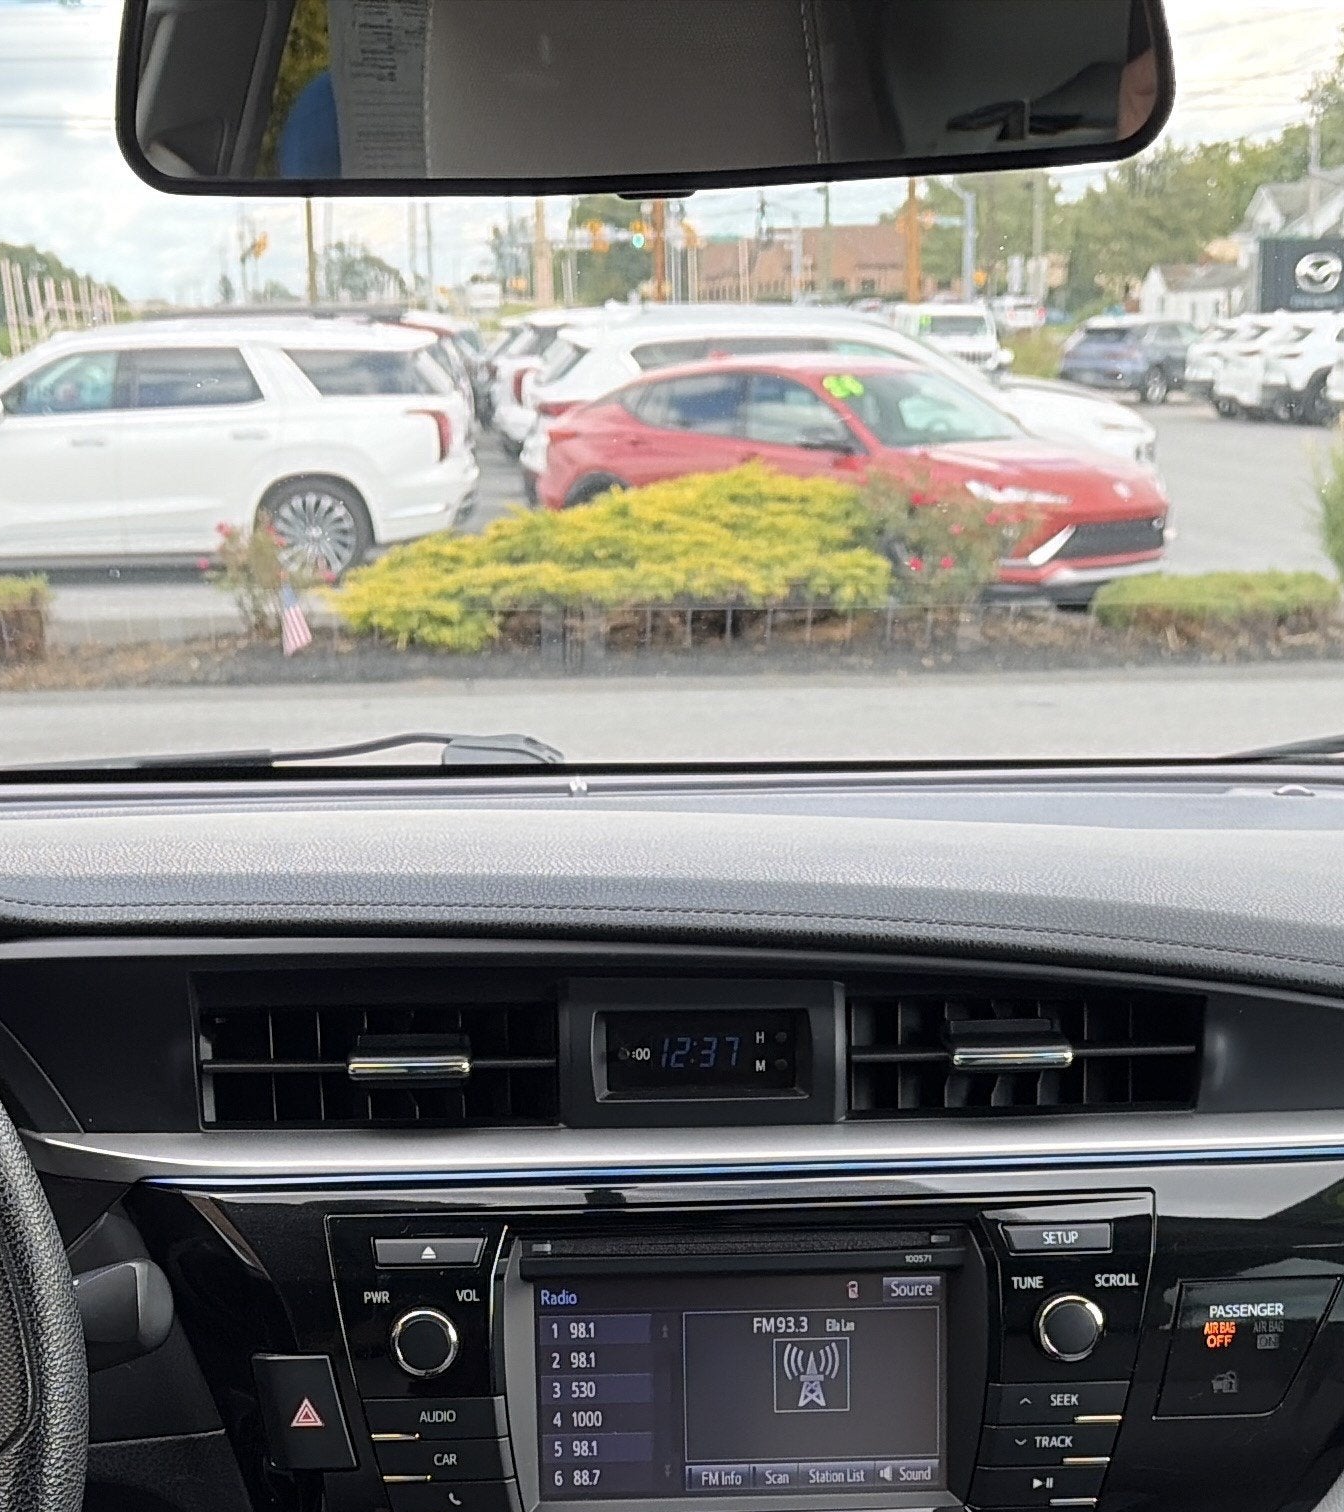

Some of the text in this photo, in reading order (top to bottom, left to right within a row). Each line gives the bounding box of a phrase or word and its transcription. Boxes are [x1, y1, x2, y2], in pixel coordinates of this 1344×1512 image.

[756, 1031, 765, 1044] H
[632, 1048, 651, 1060] :00
[661, 1037, 740, 1068] 12:37
[756, 1060, 766, 1072] M
[1043, 1231, 1079, 1245] SETUP
[1012, 1276, 1044, 1289] TUNE
[1095, 1274, 1139, 1287] SCROLL
[456, 1290, 480, 1302] VOL
[891, 1281, 933, 1297] Source
[364, 1292, 390, 1303] PWR
[541, 1290, 577, 1305] Radio
[1210, 1303, 1284, 1318] PASSENGER
[552, 1323, 595, 1339] 1 98.1
[1204, 1322, 1236, 1335] AIR BAG
[1253, 1321, 1284, 1333] AIR BAG
[1207, 1335, 1233, 1348] OFF
[552, 1352, 596, 1368] 2 98.1
[553, 1382, 596, 1398] 3 530
[1051, 1394, 1079, 1406] SEEK
[420, 1411, 456, 1423] AUDIO
[553, 1411, 602, 1427] 4 1000
[555, 1441, 598, 1457] 5 98.1
[1035, 1436, 1073, 1448] TRACK
[434, 1454, 457, 1466] CAR
[555, 1470, 601, 1486] 6 88.7
[702, 1470, 742, 1486] FM Info
[765, 1470, 789, 1484] Scan
[809, 1468, 865, 1484] Station List
[900, 1466, 931, 1481] Sound
